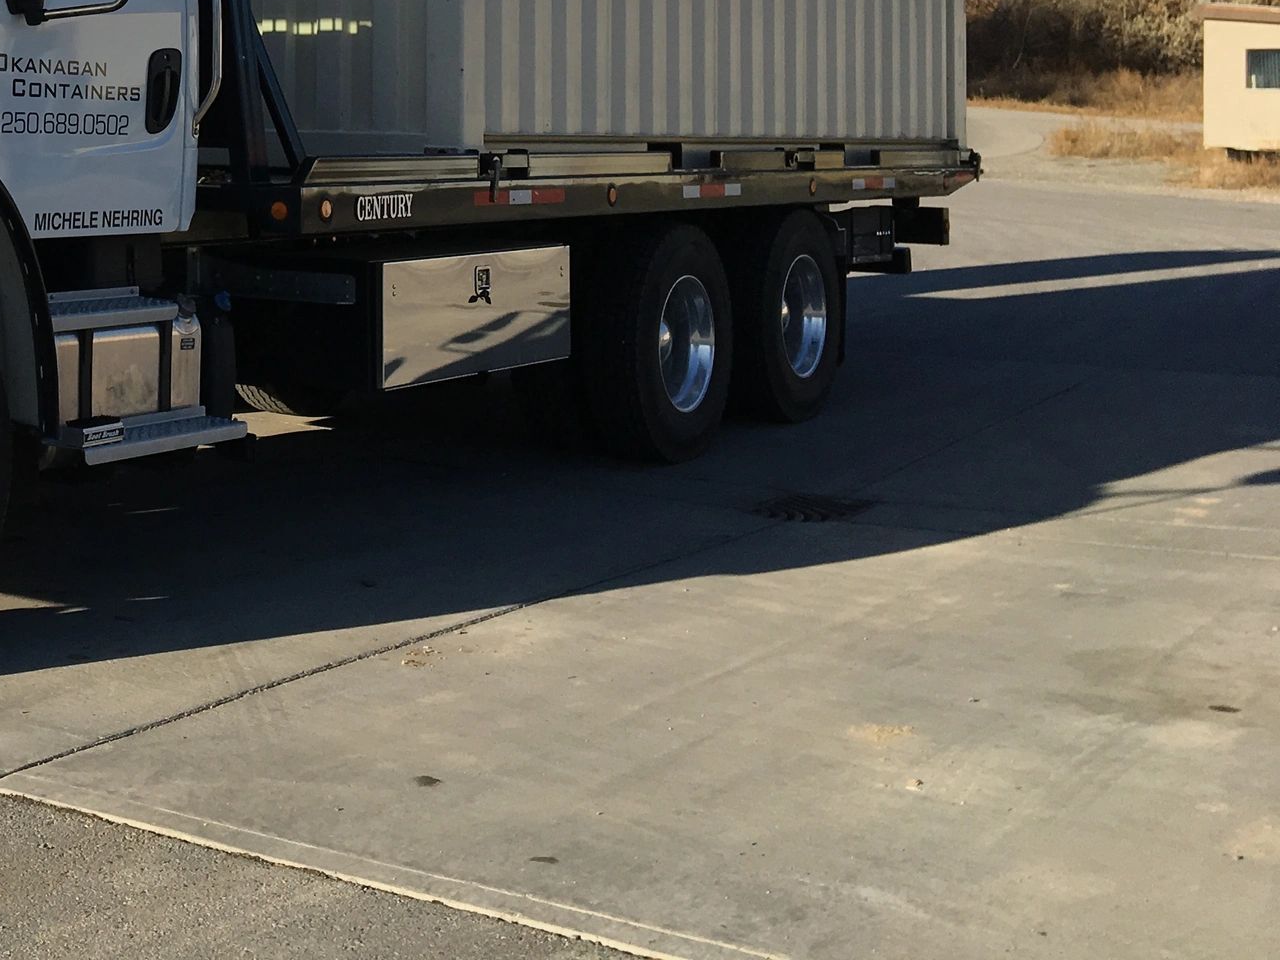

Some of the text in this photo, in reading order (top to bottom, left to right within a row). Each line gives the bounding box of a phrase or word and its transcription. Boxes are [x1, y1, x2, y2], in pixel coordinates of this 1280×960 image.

[12, 78, 141, 102] CONTAINERS
[1, 111, 130, 136] 250.689.0502
[357, 193, 414, 221] CENTURY
[33, 209, 163, 231] MICHELE NEHRING
